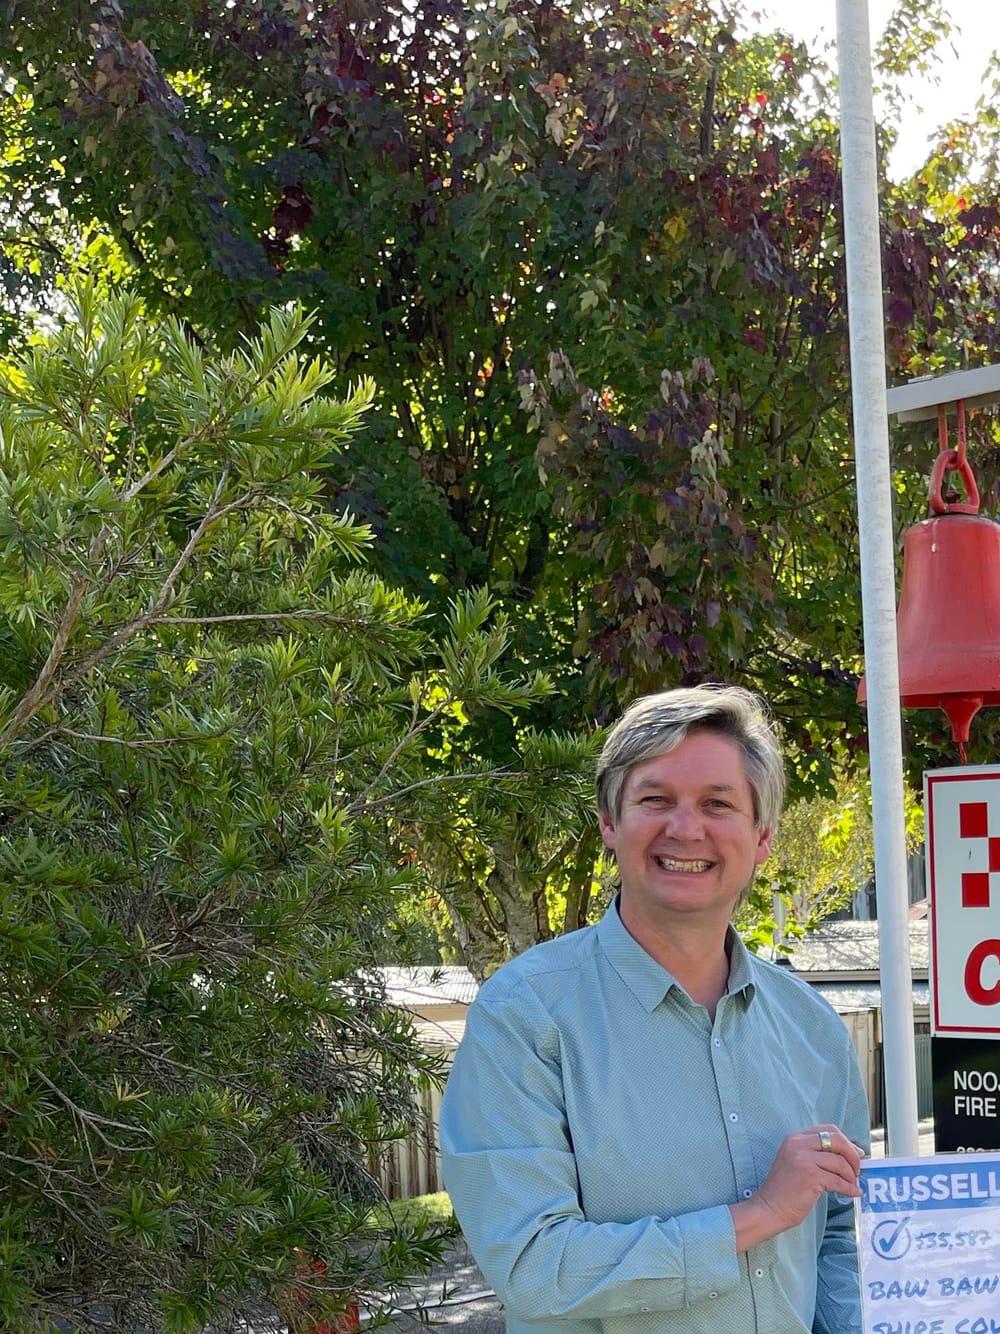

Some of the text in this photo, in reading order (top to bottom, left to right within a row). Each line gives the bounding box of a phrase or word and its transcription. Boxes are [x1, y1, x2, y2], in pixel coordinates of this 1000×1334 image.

[954, 1096, 998, 1118] FIRE
[868, 1275, 1000, 1301] BAW BAW
